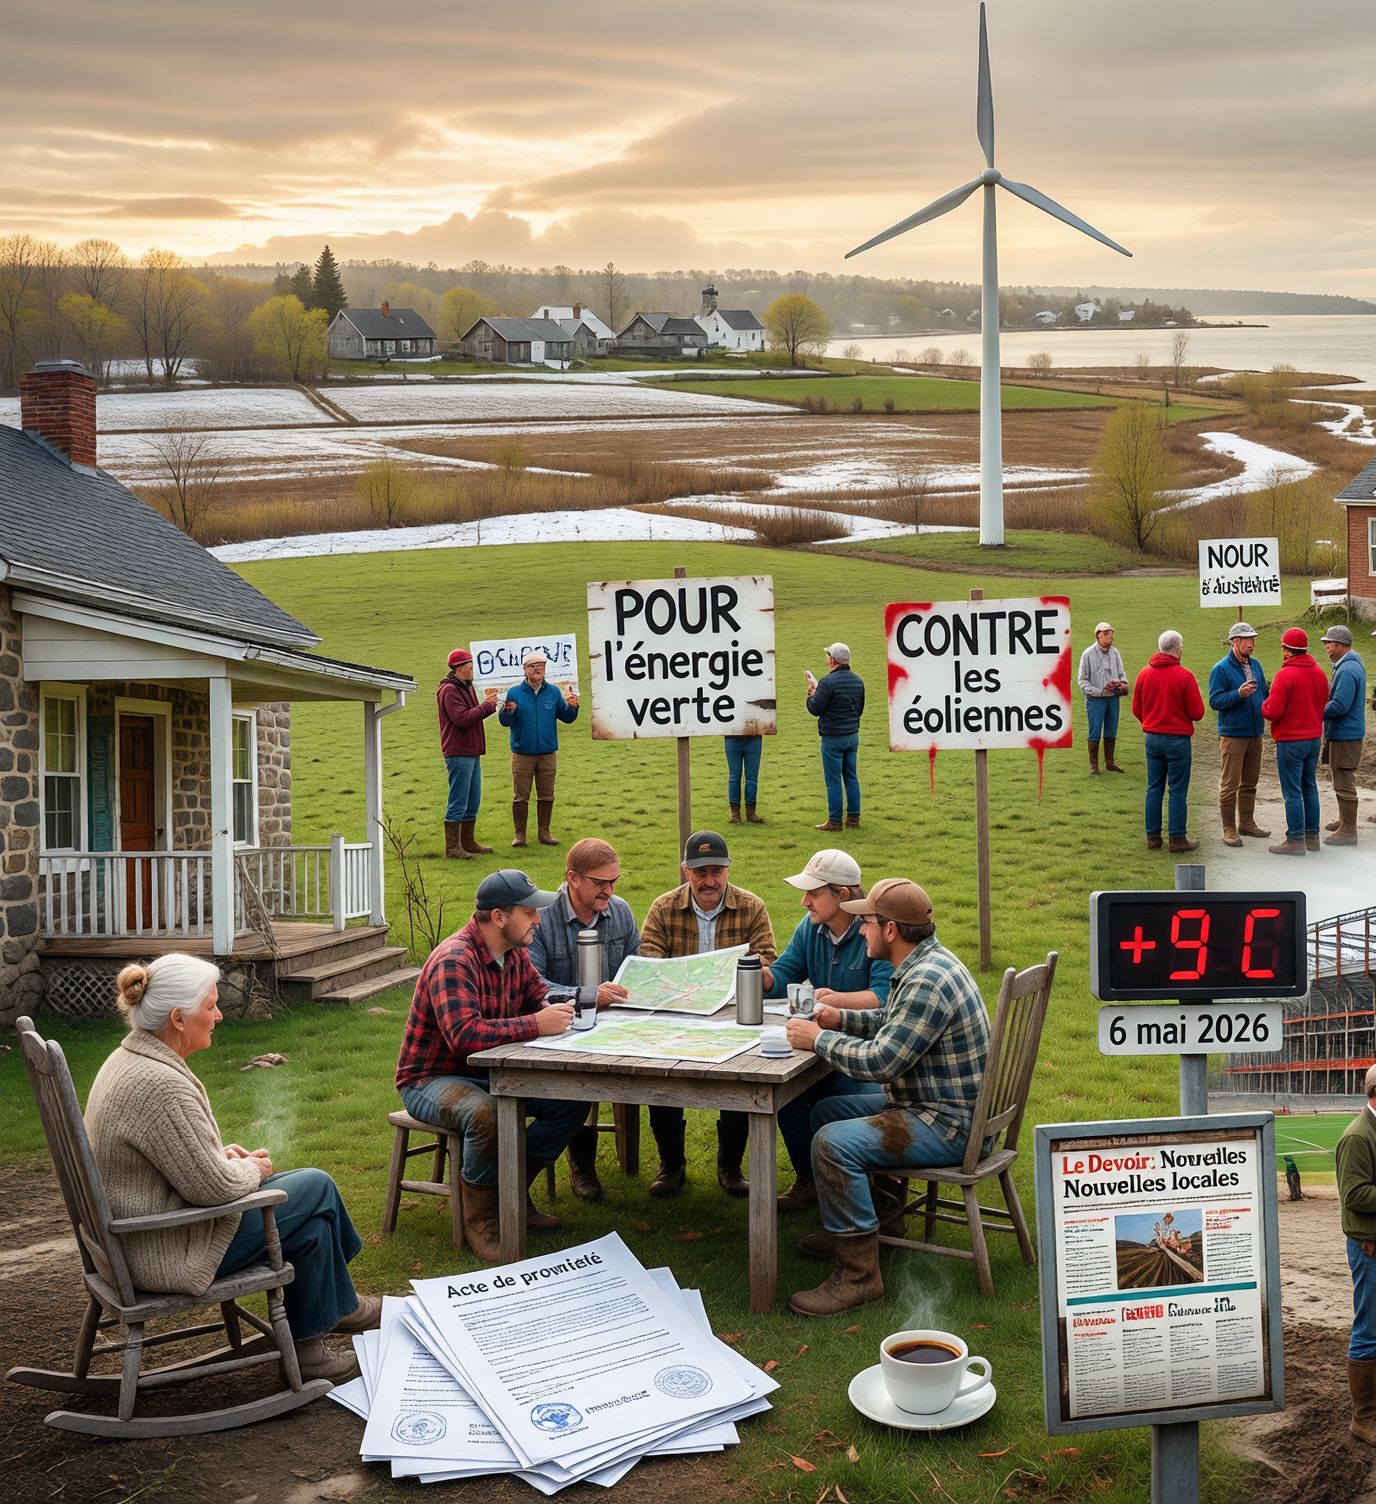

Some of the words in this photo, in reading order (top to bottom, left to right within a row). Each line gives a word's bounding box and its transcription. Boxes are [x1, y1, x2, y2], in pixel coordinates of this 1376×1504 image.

[1208, 543, 1269, 569] NOUR
[615, 585, 741, 636] POUR
[896, 609, 1060, 658] CONTRE
[604, 640, 764, 690] l'énergie
[954, 660, 1001, 693] les
[627, 687, 735, 726] verte
[903, 695, 1063, 734] éoliennes
[1109, 1016, 1127, 1046] 6
[1137, 1014, 1186, 1044] mai
[1197, 1013, 1269, 1043] 2026
[1062, 1156, 1084, 1175] Le
[1088, 1151, 1156, 1174] Devoir:
[1063, 1174, 1166, 1198] Nouvelles
[1172, 1169, 1240, 1191] locales
[447, 1281, 489, 1299] Acte
[493, 1275, 516, 1289] de
